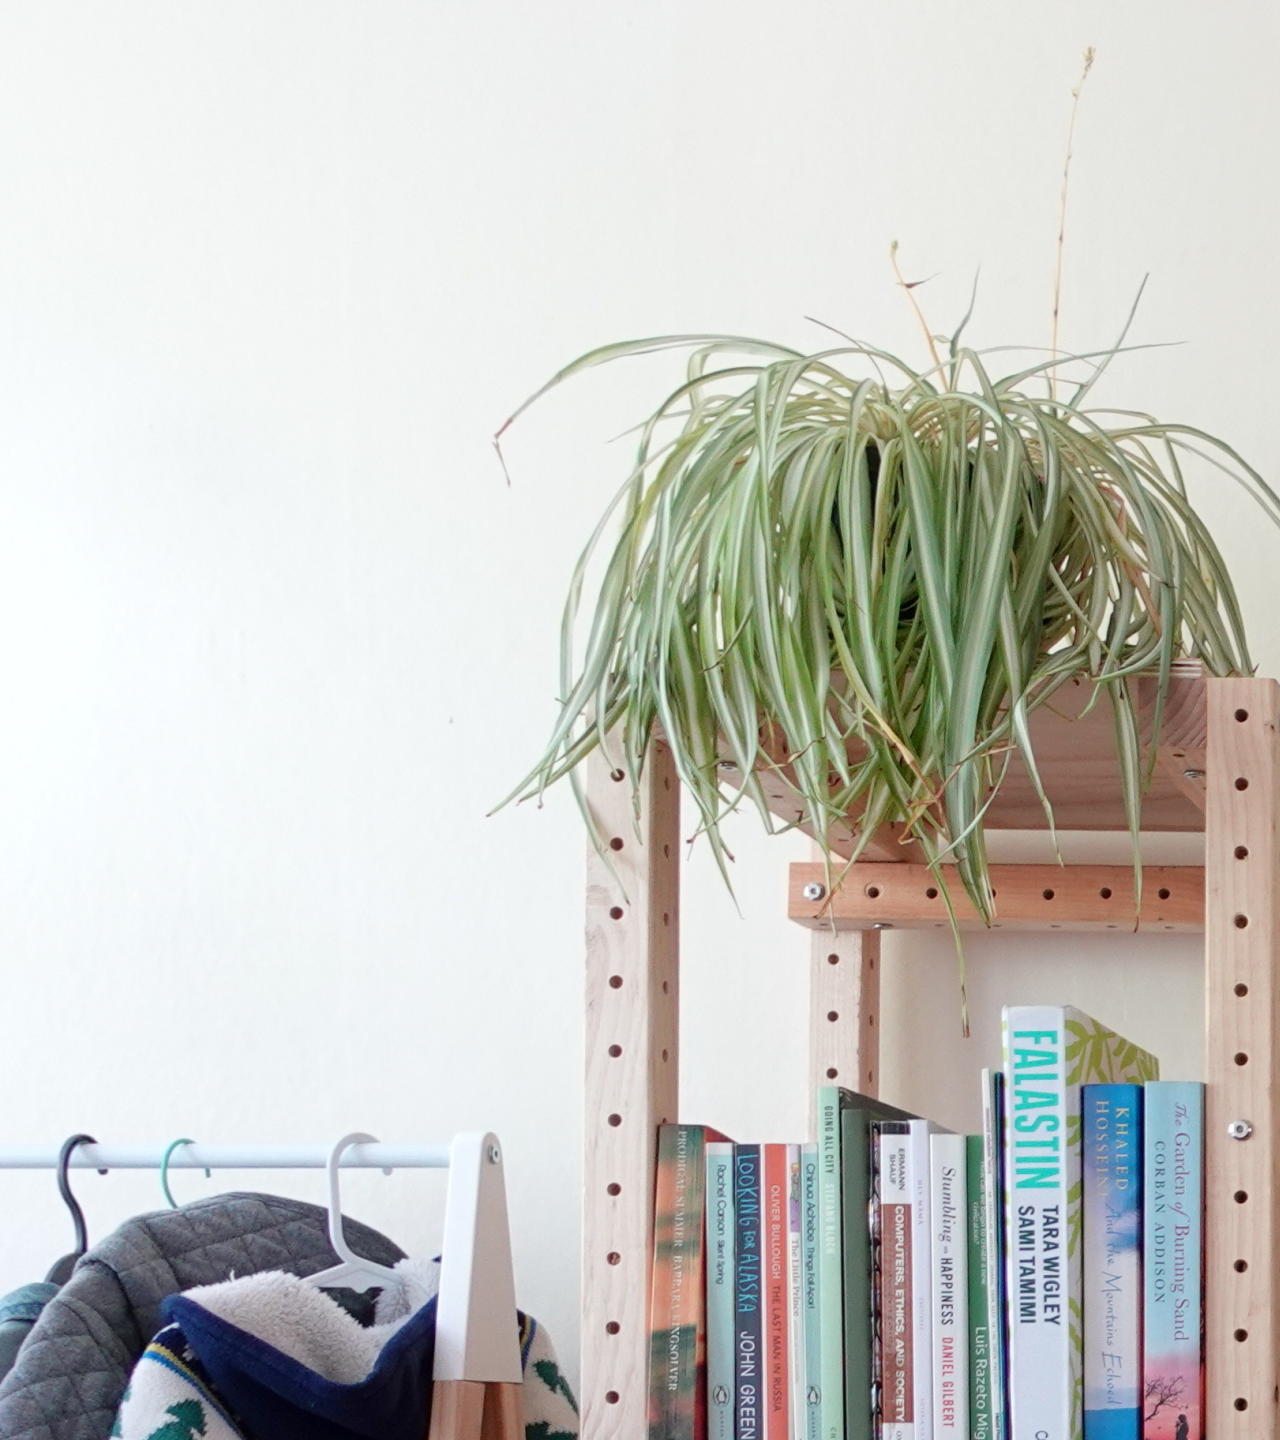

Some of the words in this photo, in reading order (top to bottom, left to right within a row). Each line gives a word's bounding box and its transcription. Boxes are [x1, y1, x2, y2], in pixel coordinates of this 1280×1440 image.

[825, 1106, 834, 1132] GOING
[1015, 1030, 1059, 1190] FALASTIN
[825, 1136, 834, 1151] ALL
[825, 1155, 834, 1174] CITY
[1173, 1133, 1190, 1196] Garden
[736, 1154, 757, 1226] LOOKING
[805, 1163, 817, 1200] Chinua
[1153, 1141, 1166, 1213] CORBAN
[770, 1185, 781, 1221] OLIVER
[805, 1202, 817, 1242] Achebe
[938, 1166, 957, 1242] Stumbling
[894, 1206, 906, 1285] COMPUTERS,
[1020, 1206, 1036, 1251] SAMI
[1043, 1205, 1059, 1250] TARA
[771, 1224, 782, 1279] BULLOUGH
[1153, 1222, 1166, 1304] ADDISON
[1170, 1225, 1189, 1293] Burning
[738, 1253, 757, 1312] ALASKA
[770, 1286, 783, 1303] THE
[941, 1258, 955, 1326] HAPPINESS
[1020, 1261, 1036, 1324] TAMIMI
[1043, 1256, 1059, 1326] WIGLEY
[770, 1307, 783, 1330] LAST
[894, 1289, 906, 1334] ETHICS,
[1173, 1298, 1190, 1341] Sand
[740, 1331, 756, 1376] JOHN
[770, 1334, 783, 1357] MAN
[894, 1341, 906, 1366] AND
[942, 1337, 955, 1376] DANIEL
[975, 1327, 987, 1355] Luis
[770, 1377, 783, 1411] RUSSIA
[894, 1371, 906, 1420] SOCIETY
[942, 1382, 955, 1428] GILBERT
[975, 1359, 988, 1409] Razeto
[740, 1384, 756, 1440] GREEN
